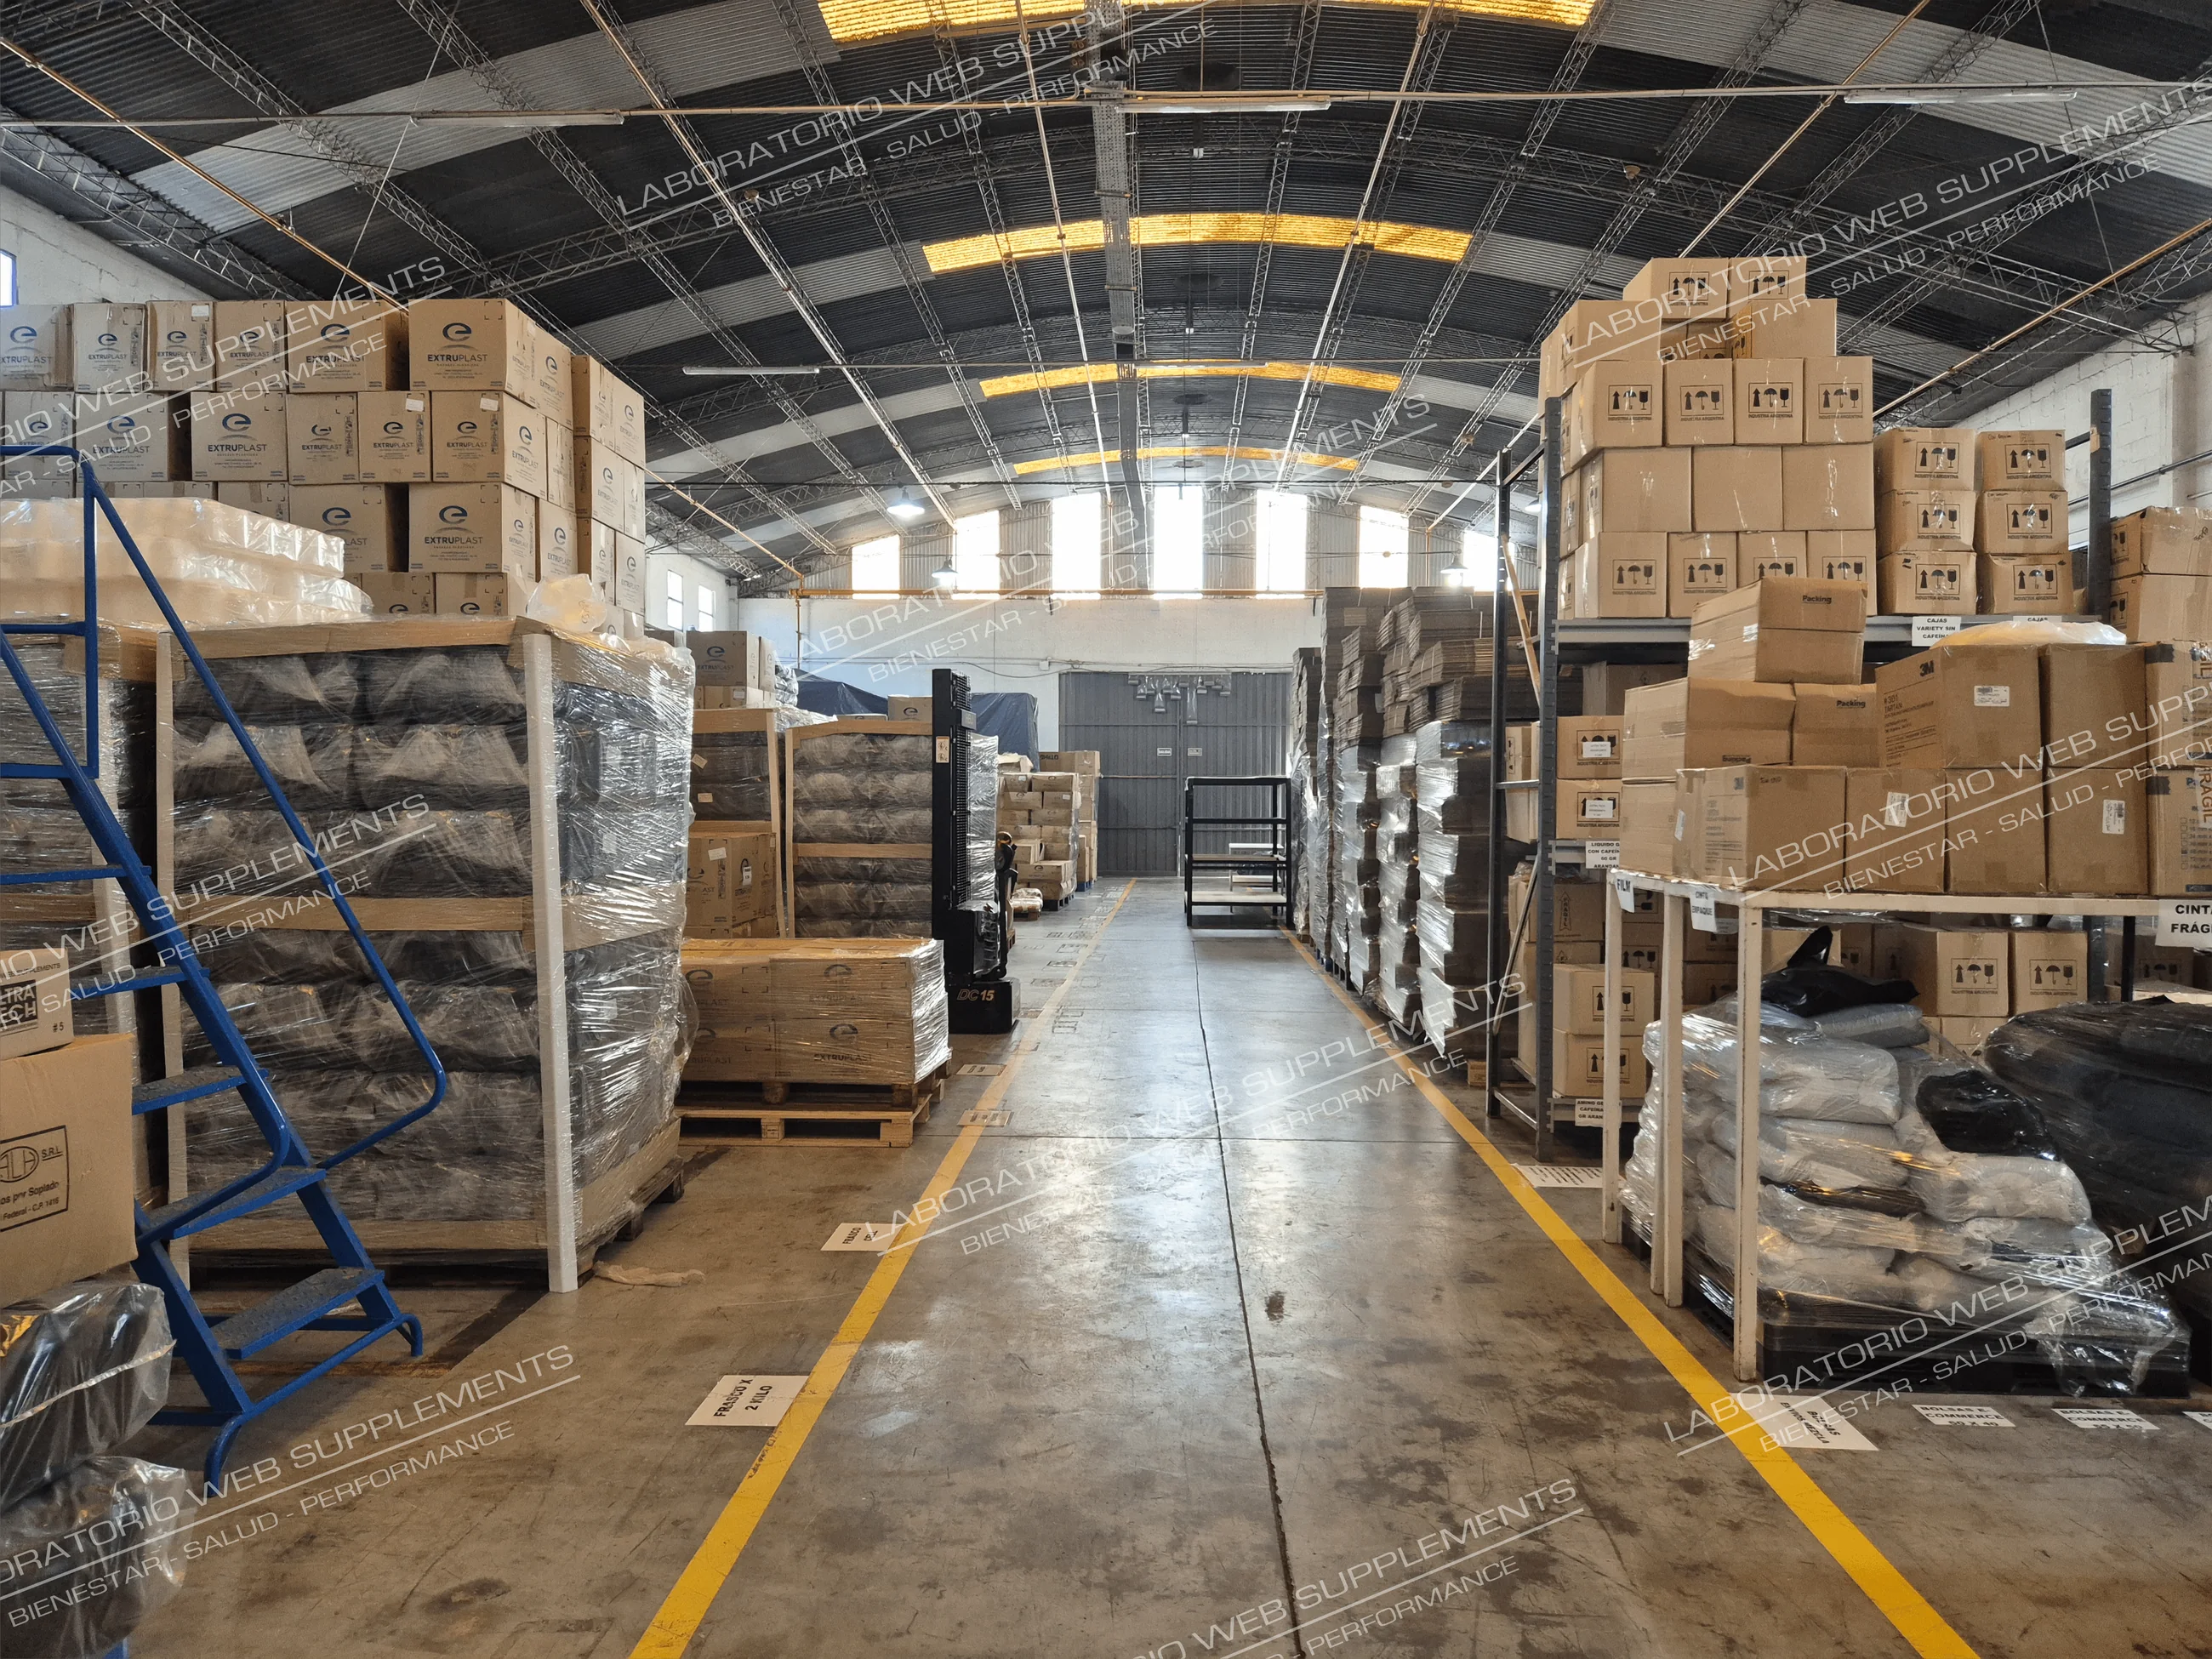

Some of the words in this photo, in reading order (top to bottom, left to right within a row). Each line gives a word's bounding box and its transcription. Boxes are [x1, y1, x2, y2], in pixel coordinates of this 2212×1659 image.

[0, 356, 53, 365] XTRUPLAST
[427, 354, 488, 363] EXTRUPLAST
[93, 445, 150, 453] EXTRUPLAST
[208, 443, 267, 453] EXTRUPLAST
[512, 449, 539, 469] EXTRUPLAST
[424, 536, 483, 544] EXTRUPLAST
[1803, 595, 1832, 604] Packing
[1919, 660, 1935, 677] 3M
[1837, 699, 1866, 708] Packing
[1616, 878, 1631, 893] FILM
[2170, 921, 2212, 934] FRÁG
[0, 984, 35, 1006] LTRA
[957, 989, 979, 1001] DC
[980, 989, 995, 1001] 15
[0, 1001, 37, 1021] ECH
[28, 1180, 60, 1197] Soplado
[3, 1207, 27, 1220] Federal
[750, 1385, 772, 1404] KILO
[714, 1386, 747, 1417] FRASCO
